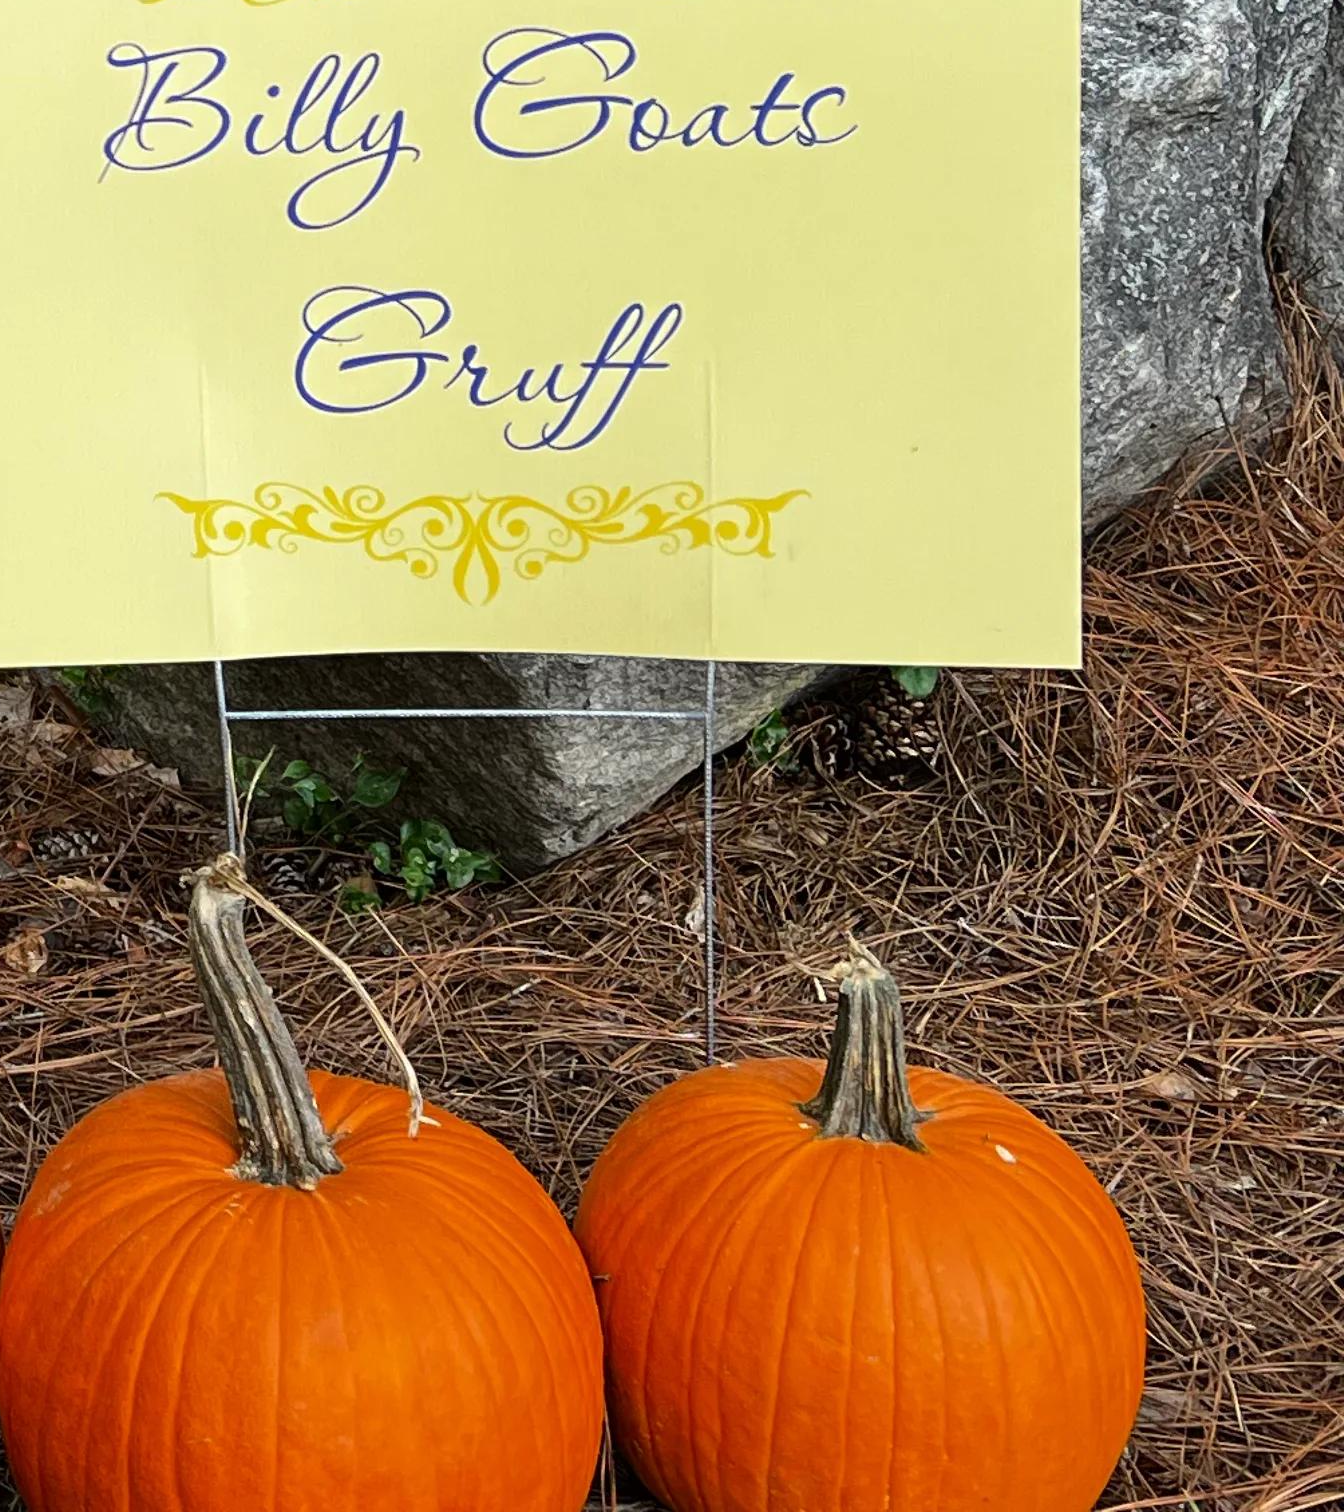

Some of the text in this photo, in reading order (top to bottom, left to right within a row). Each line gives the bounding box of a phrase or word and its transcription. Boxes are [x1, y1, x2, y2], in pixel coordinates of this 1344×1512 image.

[99, 27, 858, 231] Billy Goats
[293, 285, 682, 451] Gruff
